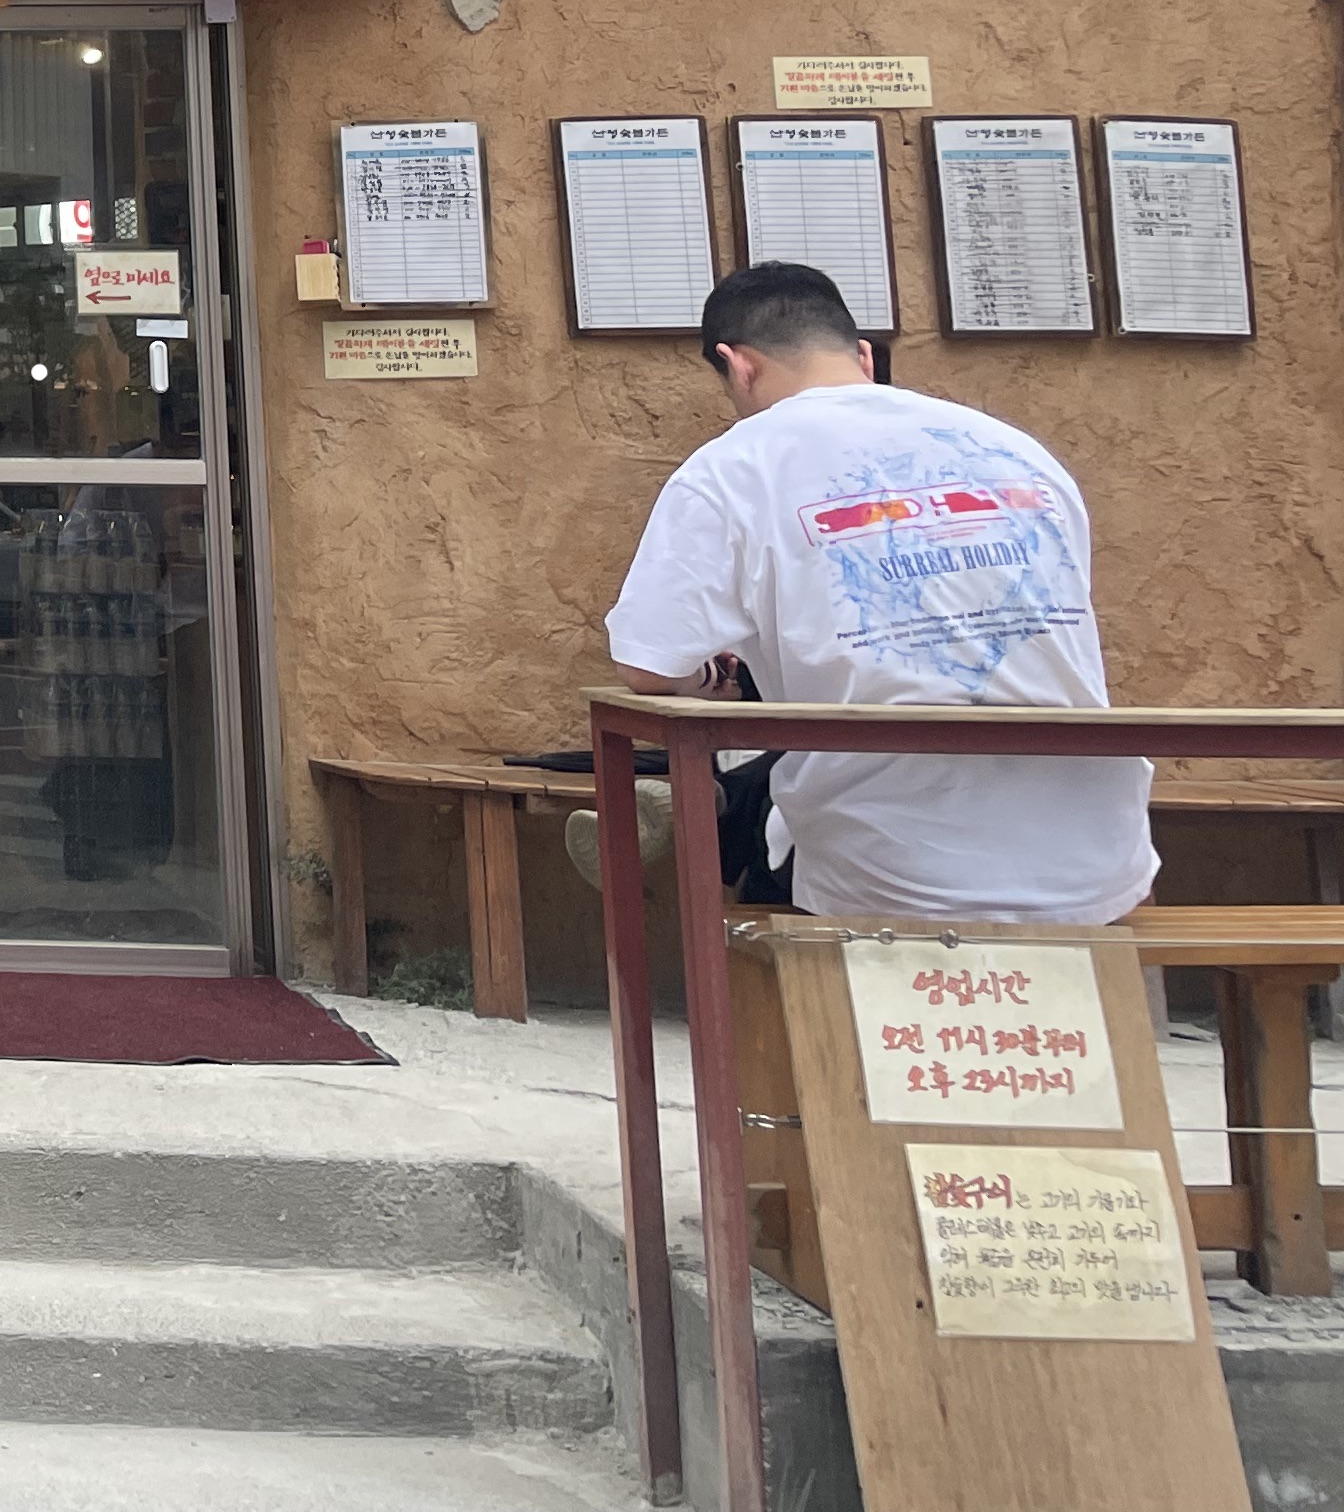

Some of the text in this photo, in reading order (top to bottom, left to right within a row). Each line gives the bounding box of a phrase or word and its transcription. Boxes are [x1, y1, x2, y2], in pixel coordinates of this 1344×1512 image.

[878, 540, 1032, 582] SURREAL HOLIDAY
[912, 969, 1032, 1006] 영업시간
[881, 1023, 925, 1054] 오전
[936, 1025, 989, 1056] 11시
[907, 1061, 955, 1099] 오후
